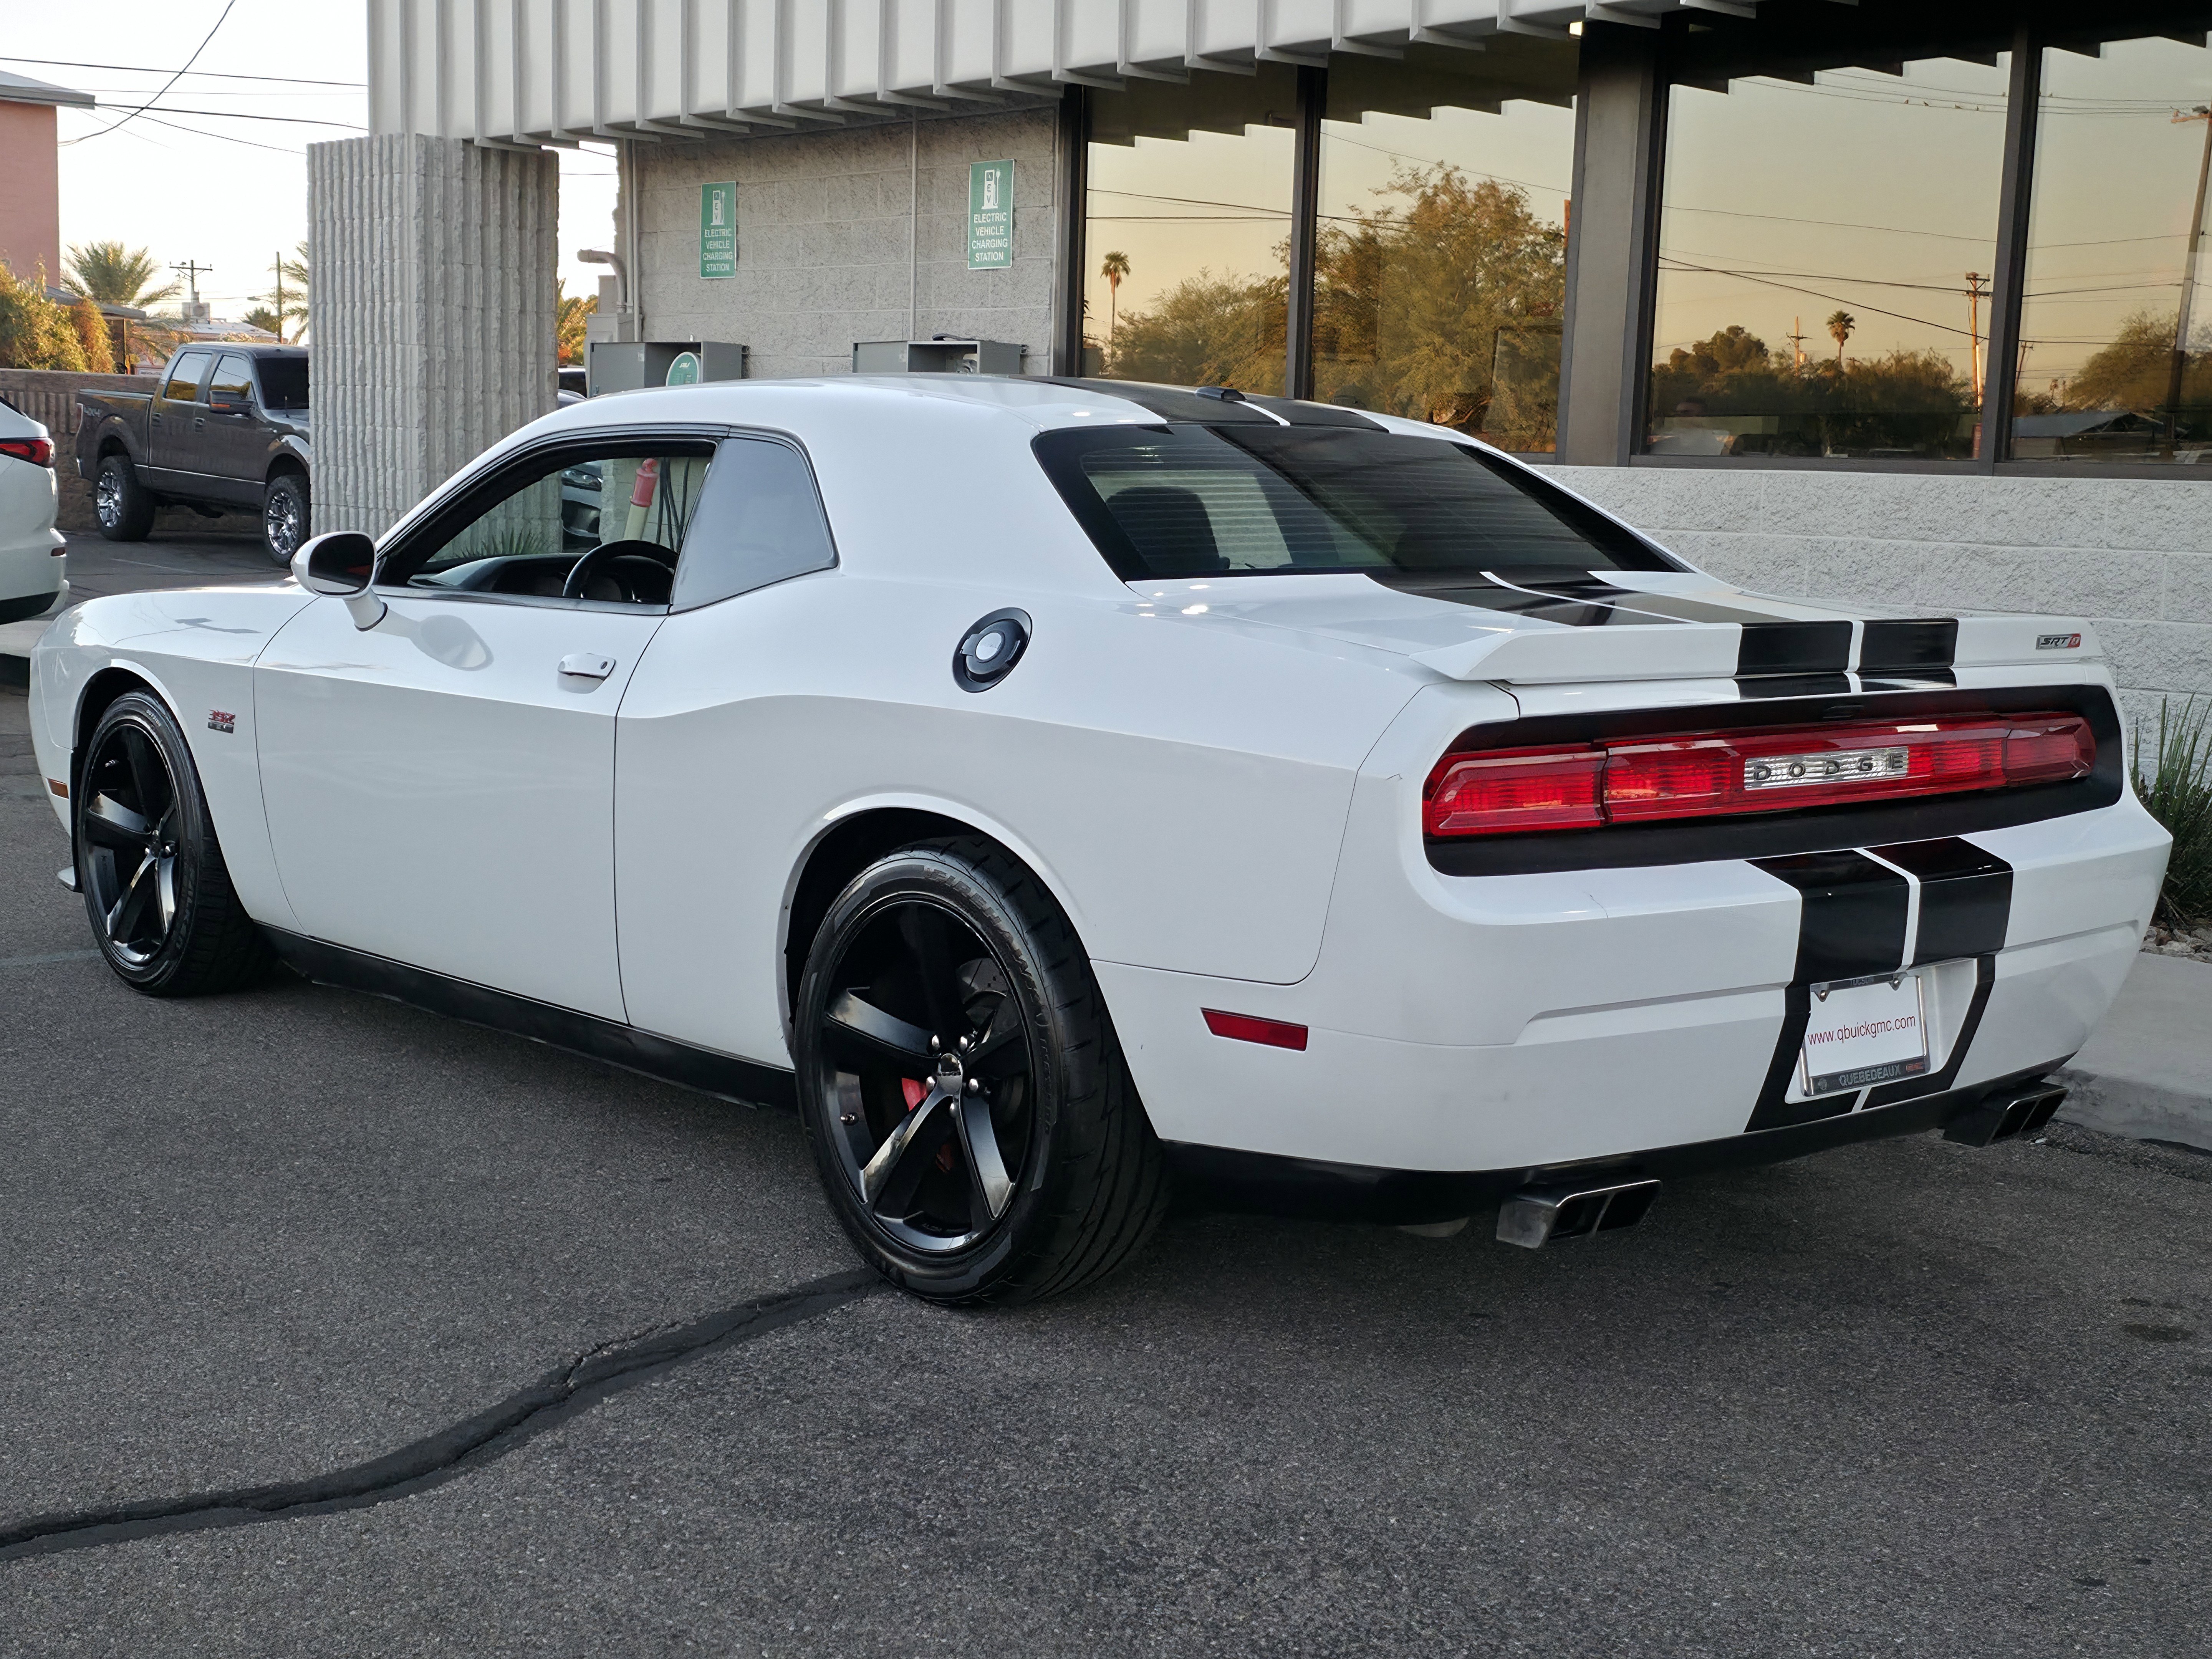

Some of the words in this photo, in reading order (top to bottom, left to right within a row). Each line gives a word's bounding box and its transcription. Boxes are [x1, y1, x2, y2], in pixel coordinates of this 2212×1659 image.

[974, 212, 1007, 223] ELECTRIC
[705, 228, 732, 237] ELECTRIC
[975, 225, 1004, 236] VEHICLE
[706, 240, 730, 249] VEHICLE
[972, 238, 1008, 249] CHARGING
[703, 252, 733, 261] CHARGING
[975, 252, 1003, 262] STATION
[706, 263, 729, 272] STATION
[1754, 754, 1904, 780] DODGE
[1808, 1015, 1916, 1045] www.qbuickgmc.com
